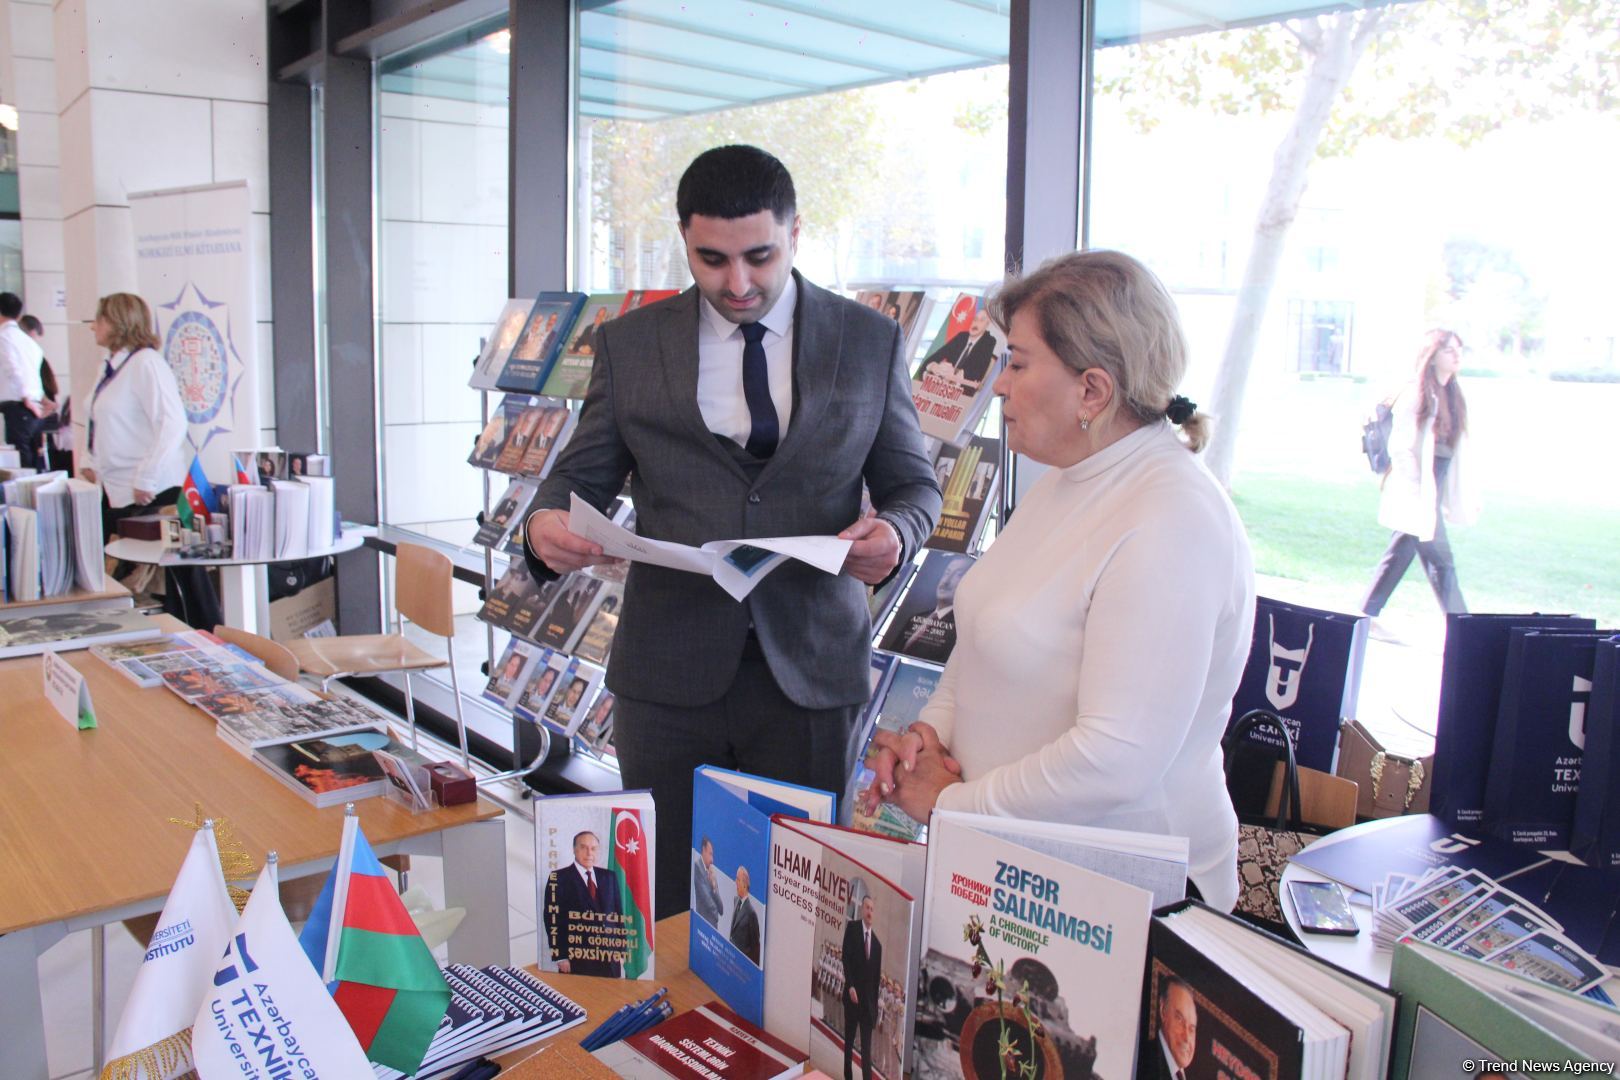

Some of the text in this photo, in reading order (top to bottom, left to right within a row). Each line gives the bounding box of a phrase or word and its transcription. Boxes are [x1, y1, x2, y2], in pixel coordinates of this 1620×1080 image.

[1554, 768, 1581, 781] TEX
[773, 843, 855, 905] ILHAM ALIYEV
[951, 872, 992, 897] ХРОНИКИ
[994, 860, 1060, 905] ZƏFƏR
[773, 868, 844, 915] 15-year presidential
[773, 883, 813, 913] SUCCESS
[814, 906, 842, 931] STORY
[951, 884, 989, 908] ПОБЕДЫ
[568, 909, 633, 925] BÜTÜN
[990, 914, 1050, 947] A CHRONICLE
[993, 888, 1113, 955] SALNAMƏSİ
[567, 934, 583, 944] ƏN
[989, 926, 1040, 955] OF VICTORY
[253, 983, 320, 1080] Azərbayca
